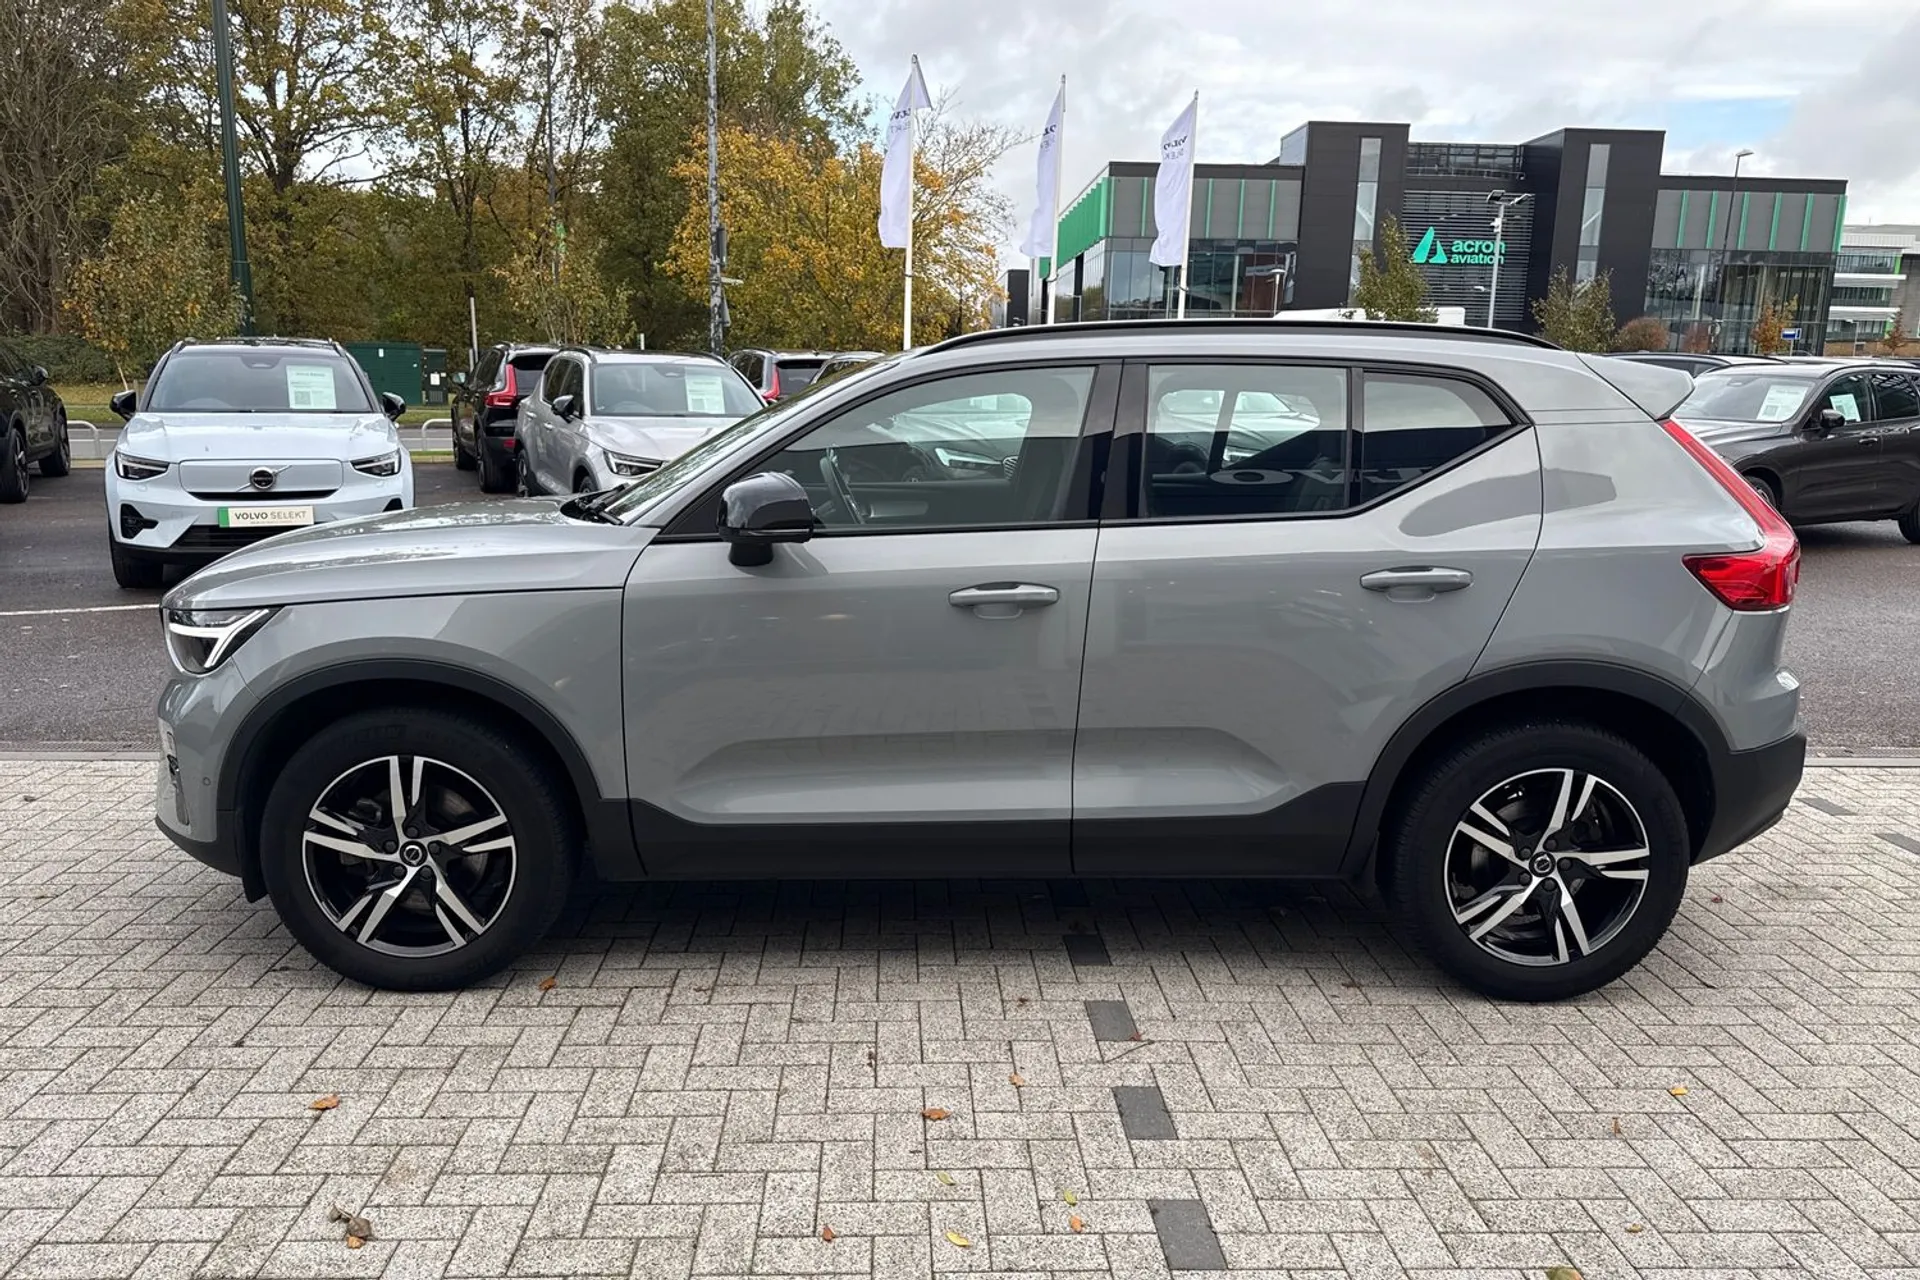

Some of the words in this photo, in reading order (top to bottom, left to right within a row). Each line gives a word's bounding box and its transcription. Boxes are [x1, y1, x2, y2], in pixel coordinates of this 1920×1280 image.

[1451, 240, 1505, 254] acron
[1450, 253, 1504, 265] aviation
[234, 511, 268, 520] VOLVO
[269, 510, 307, 520] SELEKT
